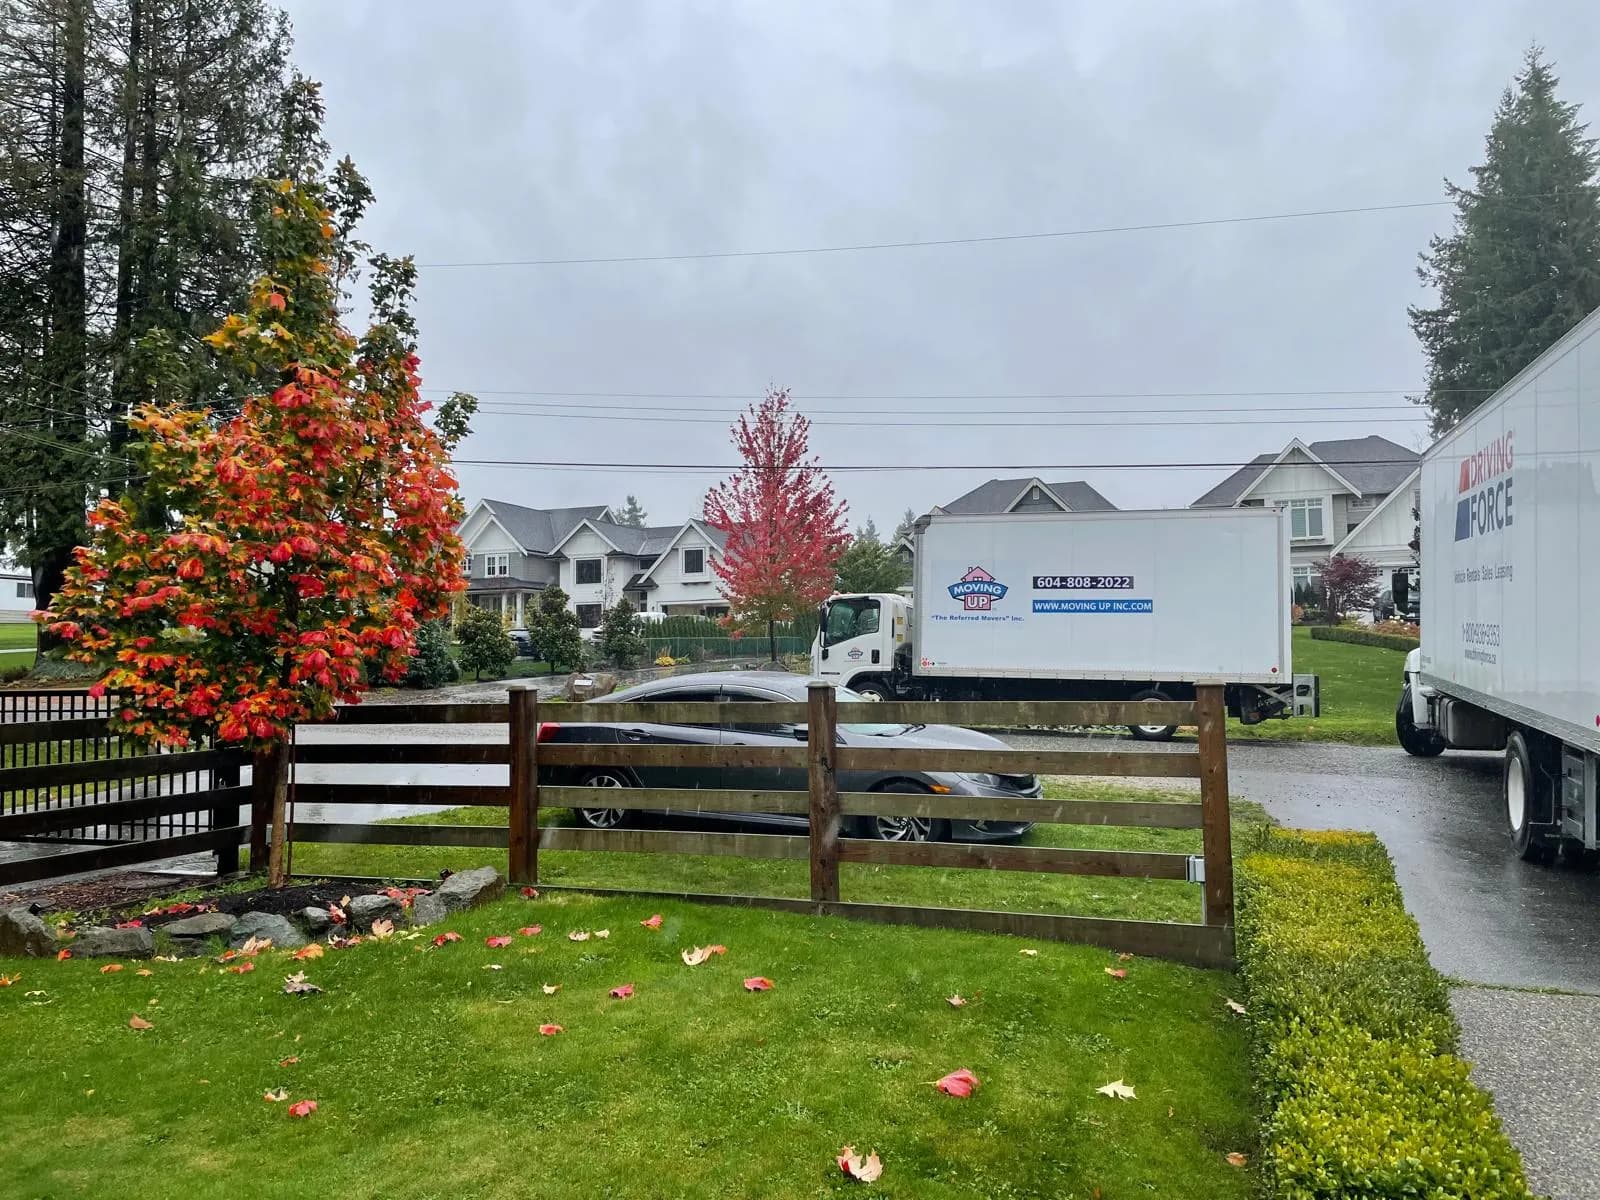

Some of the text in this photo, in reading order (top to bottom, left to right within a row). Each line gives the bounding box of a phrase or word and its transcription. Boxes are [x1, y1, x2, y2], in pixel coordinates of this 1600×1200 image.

[1471, 430, 1513, 488] DRIVING
[1471, 477, 1513, 537] FORCE
[1495, 562, 1513, 582] Leasing
[1037, 577, 1130, 588] 604-808-2022
[953, 583, 1002, 595] MOVING
[967, 596, 989, 608] UP
[1034, 602, 1152, 611] WWW.MOVING UP INC.COM
